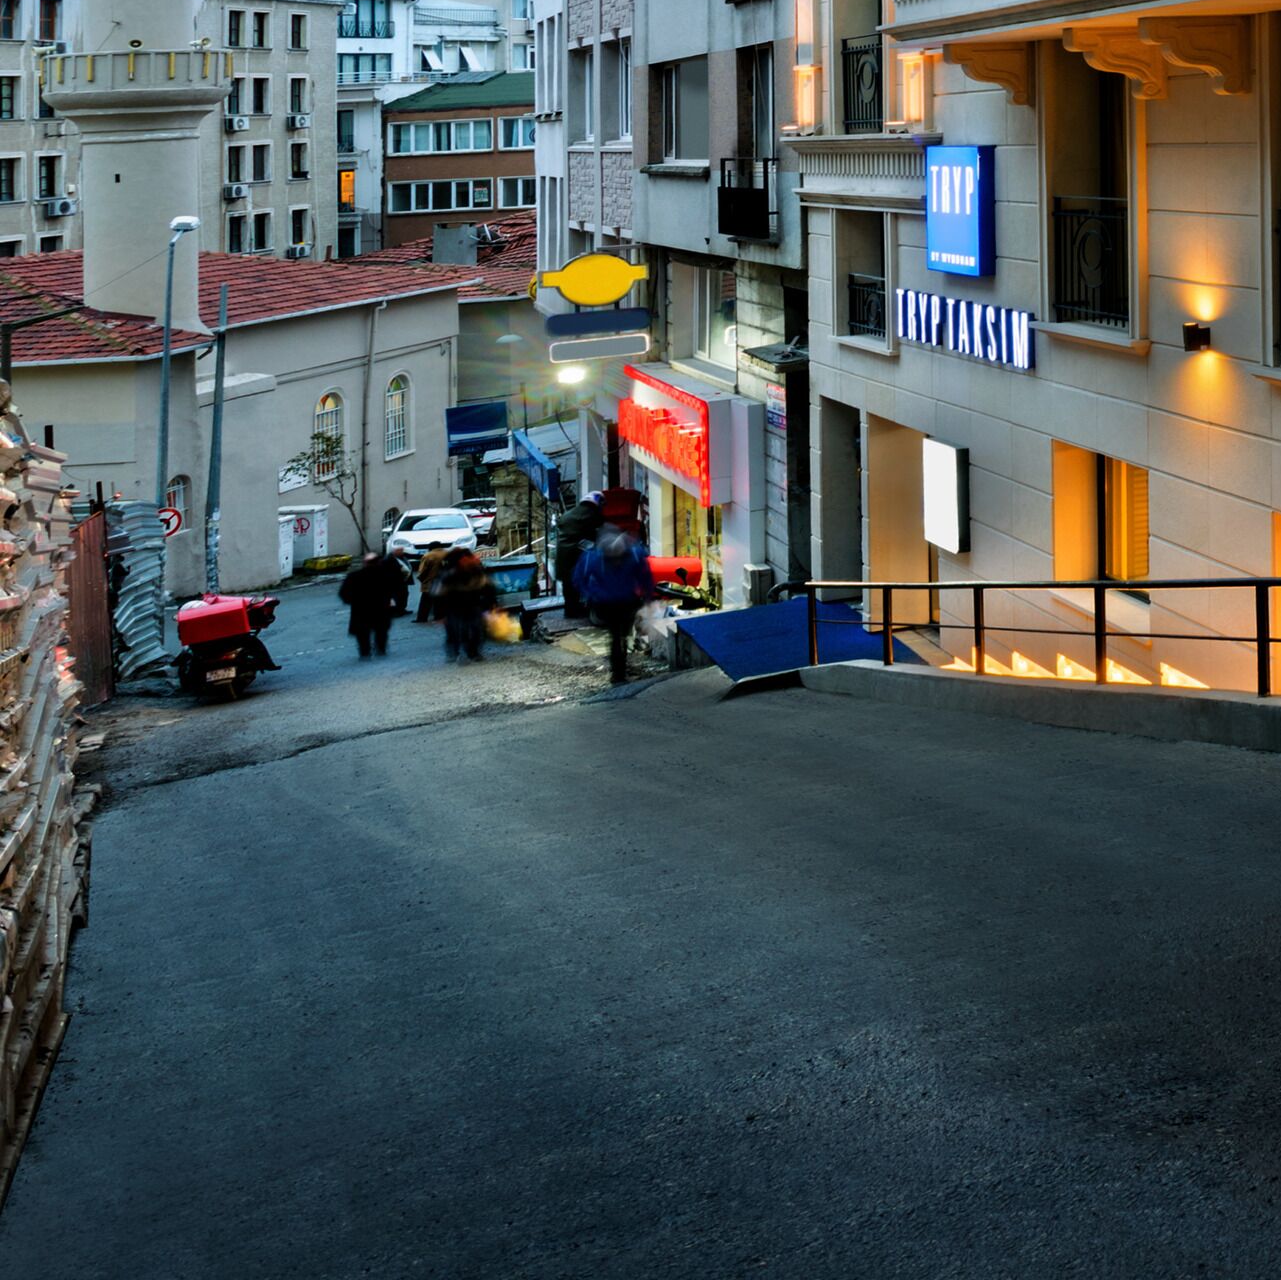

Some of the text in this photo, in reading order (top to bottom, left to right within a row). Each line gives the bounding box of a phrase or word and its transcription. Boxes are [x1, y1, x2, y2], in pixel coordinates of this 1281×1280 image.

[930, 165, 974, 215] TRYP
[896, 288, 1029, 369] TRYP TAKSIM
